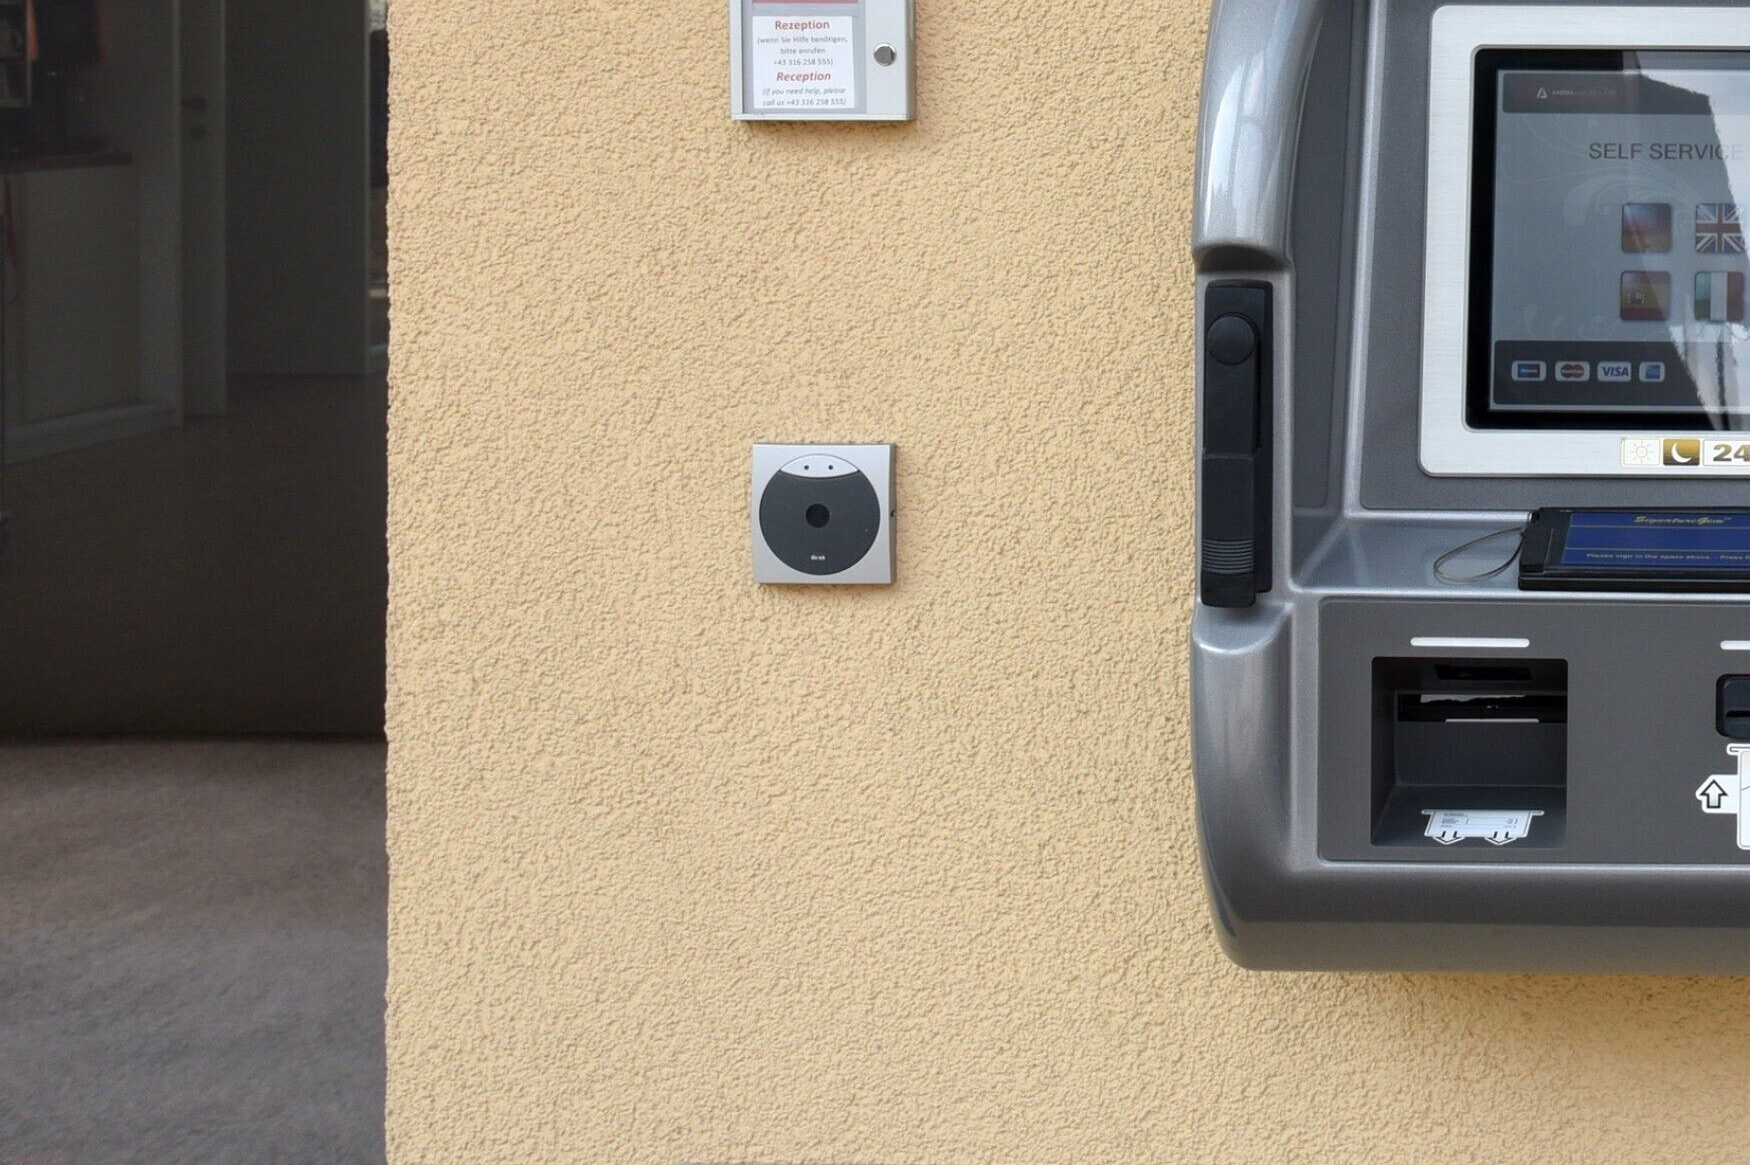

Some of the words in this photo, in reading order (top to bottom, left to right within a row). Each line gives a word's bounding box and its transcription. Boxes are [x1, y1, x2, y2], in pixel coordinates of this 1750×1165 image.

[775, 20, 830, 31] Rezeption
[793, 35, 809, 43] Hilfe
[774, 58, 786, 66] +43
[789, 58, 801, 66] 316
[776, 70, 831, 83] Reception
[786, 87, 804, 95] need
[823, 87, 846, 95] please
[1588, 141, 1643, 161] SELF
[1650, 142, 1744, 161] SERVICE
[1601, 366, 1628, 377] VISA
